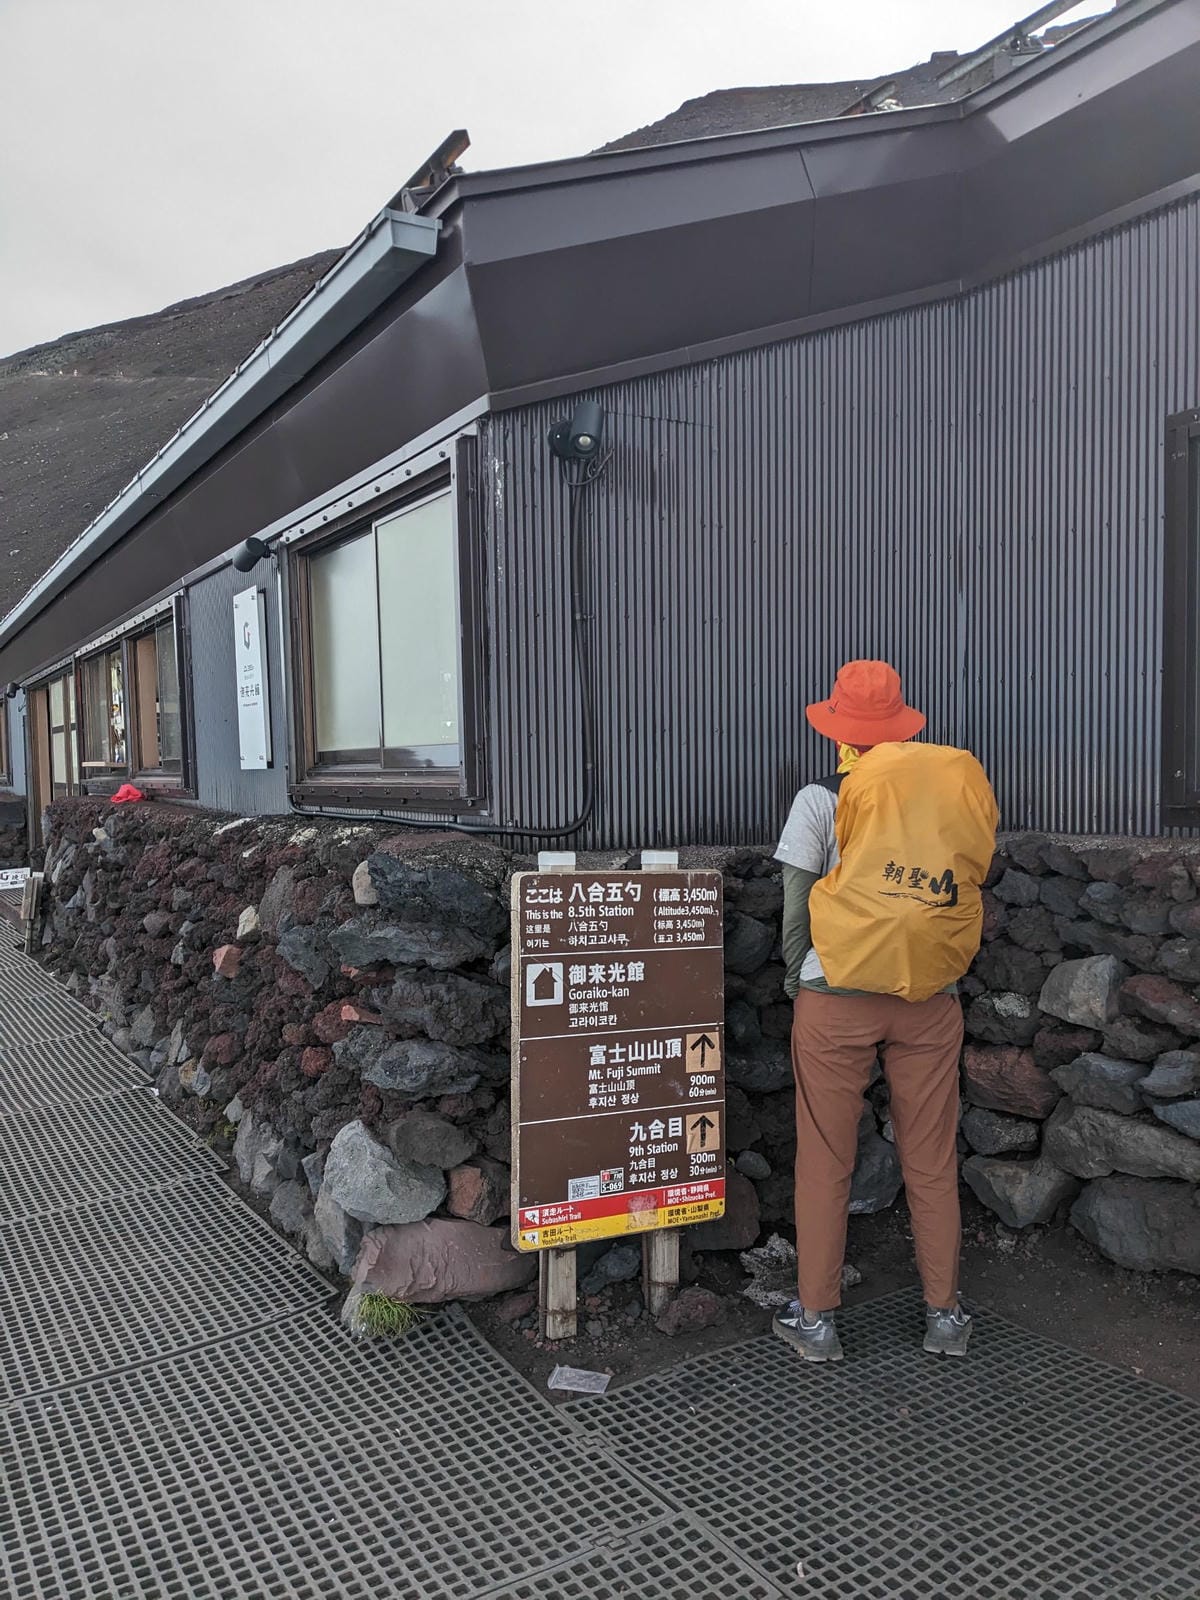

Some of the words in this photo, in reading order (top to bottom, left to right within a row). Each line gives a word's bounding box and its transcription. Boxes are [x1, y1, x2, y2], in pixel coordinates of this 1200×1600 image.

[525, 888, 563, 904] ここは
[568, 882, 641, 903] 八合五勺
[525, 910, 540, 920] This
[541, 909, 549, 920] is
[550, 909, 563, 920] the
[568, 906, 595, 918] 8.5th
[599, 905, 634, 917] Station
[525, 924, 551, 935] 这里是
[568, 920, 608, 932] 八合五勺
[568, 961, 645, 986] 御来光館
[568, 985, 630, 1000] Goraiko-kan
[568, 1014, 618, 1028] 고라이코칸
[589, 1038, 682, 1066] 富士山山頂
[588, 1069, 604, 1081] Mt.
[606, 1067, 624, 1080] Fuji
[626, 1063, 661, 1077] Summit
[690, 1075, 715, 1086] 900m
[588, 1096, 616, 1109] 후지산
[621, 1093, 640, 1106] 정상
[629, 1117, 682, 1143] 九合目
[629, 1145, 644, 1158] 9th
[647, 1142, 679, 1155] Station
[629, 1158, 656, 1171] 九合目
[690, 1153, 716, 1165] 500m
[629, 1172, 656, 1185] 후지산
[660, 1168, 678, 1180] 정상
[602, 1181, 622, 1192] S-069
[569, 1212, 582, 1220] Trail
